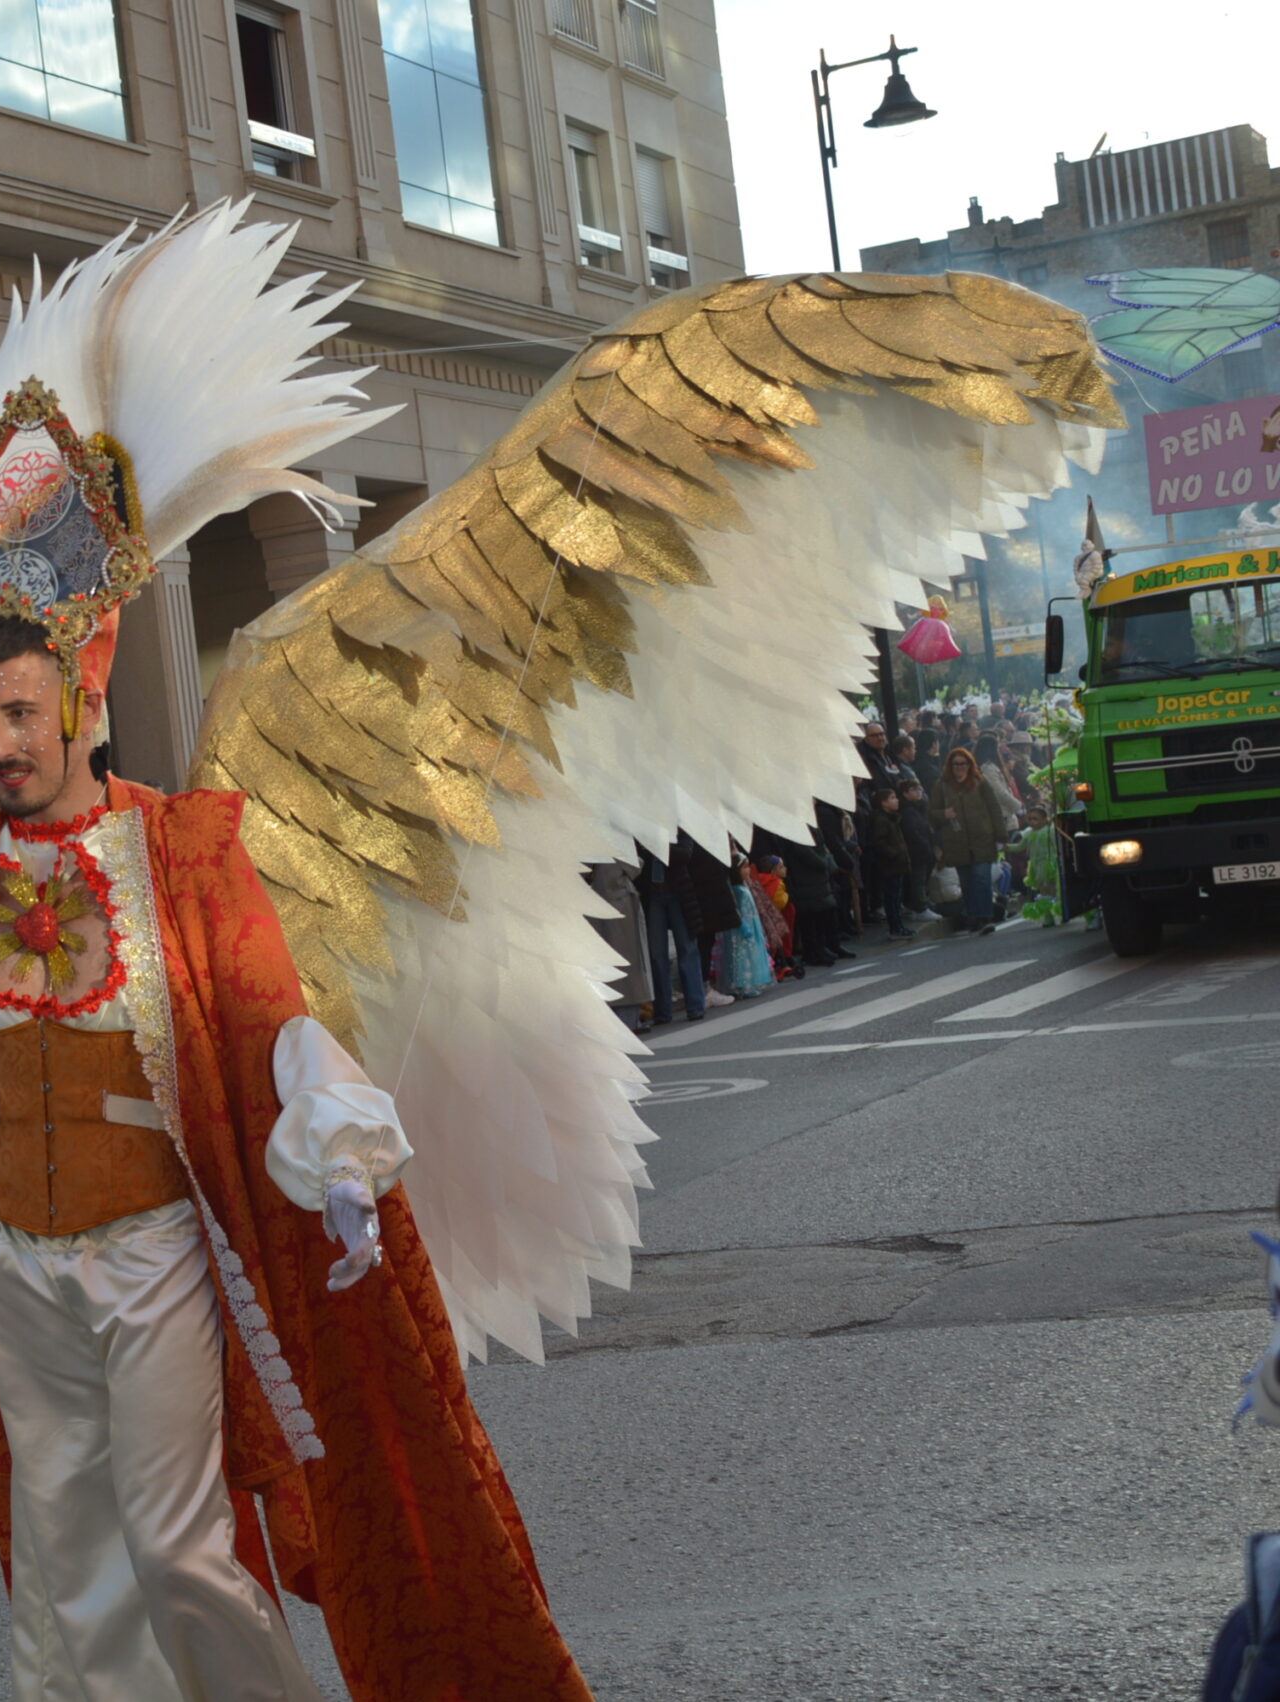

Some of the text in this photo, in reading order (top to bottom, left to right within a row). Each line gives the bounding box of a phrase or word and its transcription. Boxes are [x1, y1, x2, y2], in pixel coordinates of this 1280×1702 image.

[1160, 411, 1246, 465] PEÑA
[1157, 473, 1202, 505] NO
[1215, 467, 1252, 498] LO
[1133, 551, 1280, 592] Miriam & J
[1157, 688, 1251, 714] JopeCar
[1118, 710, 1221, 729] ELEVACIONES
[1226, 708, 1237, 719] &
[1218, 864, 1276, 882] LE 3192
